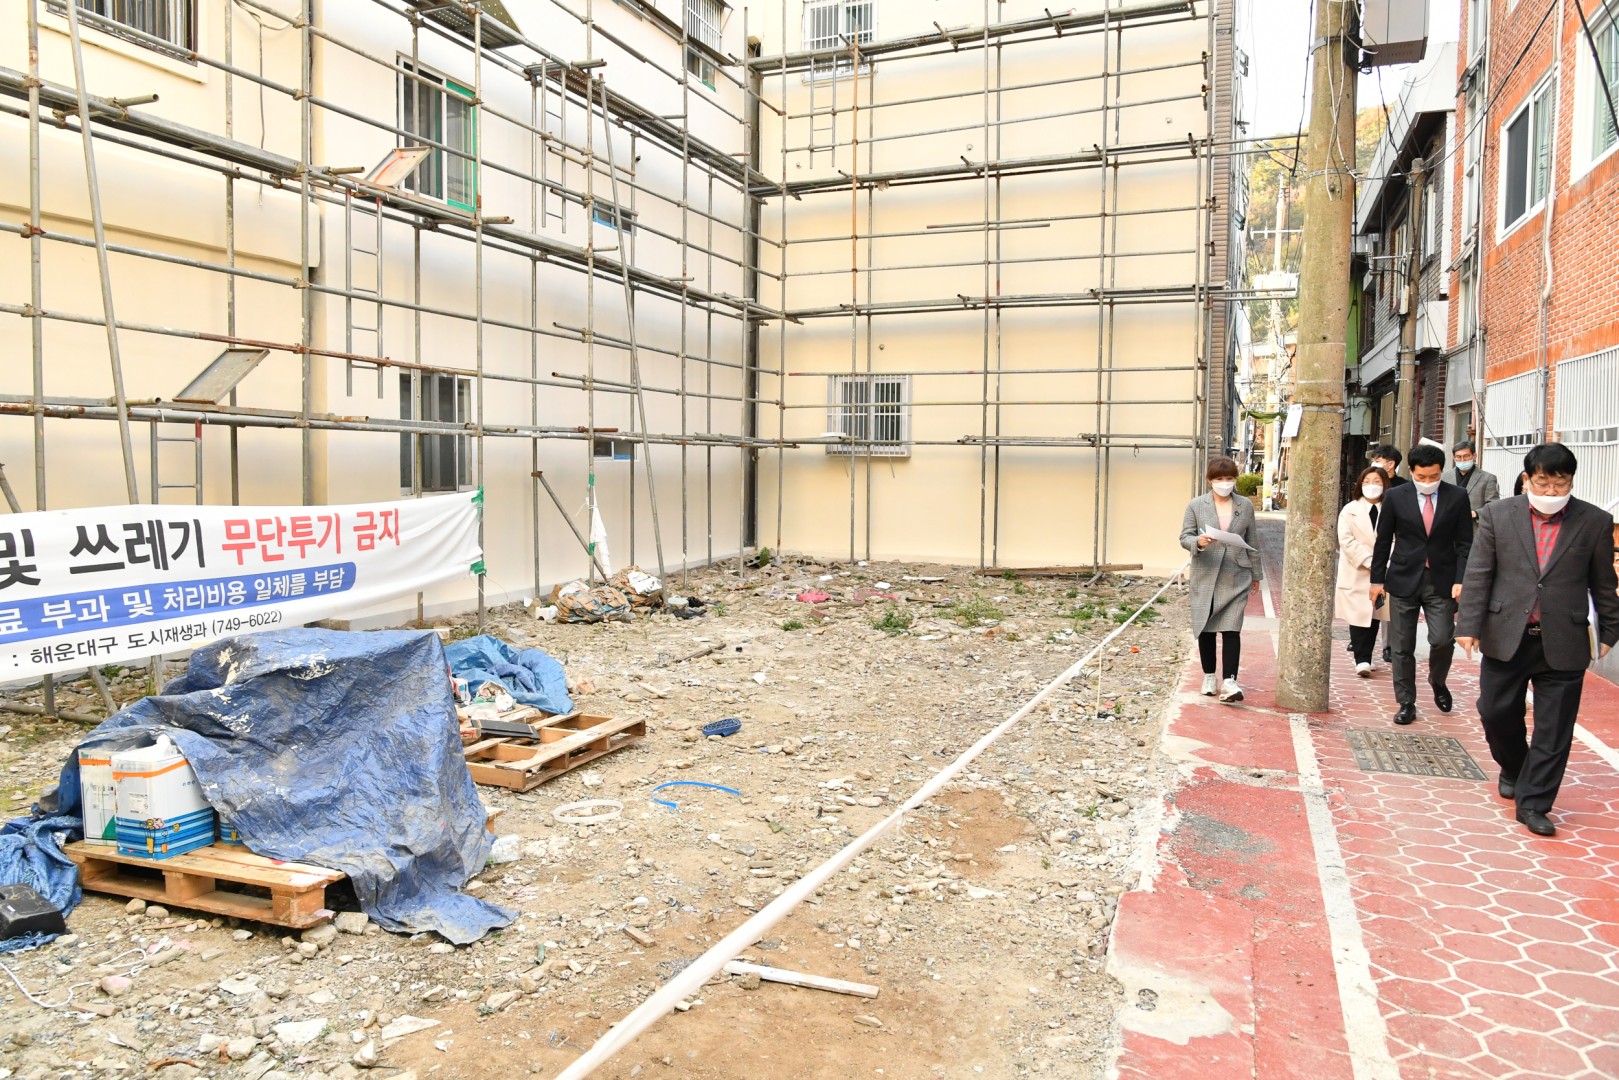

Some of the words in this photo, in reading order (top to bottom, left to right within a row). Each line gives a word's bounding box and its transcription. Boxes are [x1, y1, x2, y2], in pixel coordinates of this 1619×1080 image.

[0, 529, 41, 590] 및
[69, 519, 206, 575] 쓰레기
[222, 513, 341, 565] 무단투기
[353, 508, 400, 551] 금지
[0, 608, 28, 635] 료
[41, 595, 111, 629] 부과
[122, 589, 154, 619] 및
[163, 581, 247, 612] 처리비용
[254, 573, 307, 601] 일체를
[312, 567, 345, 592] 부담
[30, 636, 118, 664] 해운대구
[127, 622, 207, 649] 도시재생과
[212, 608, 282, 636] (749-6022)
